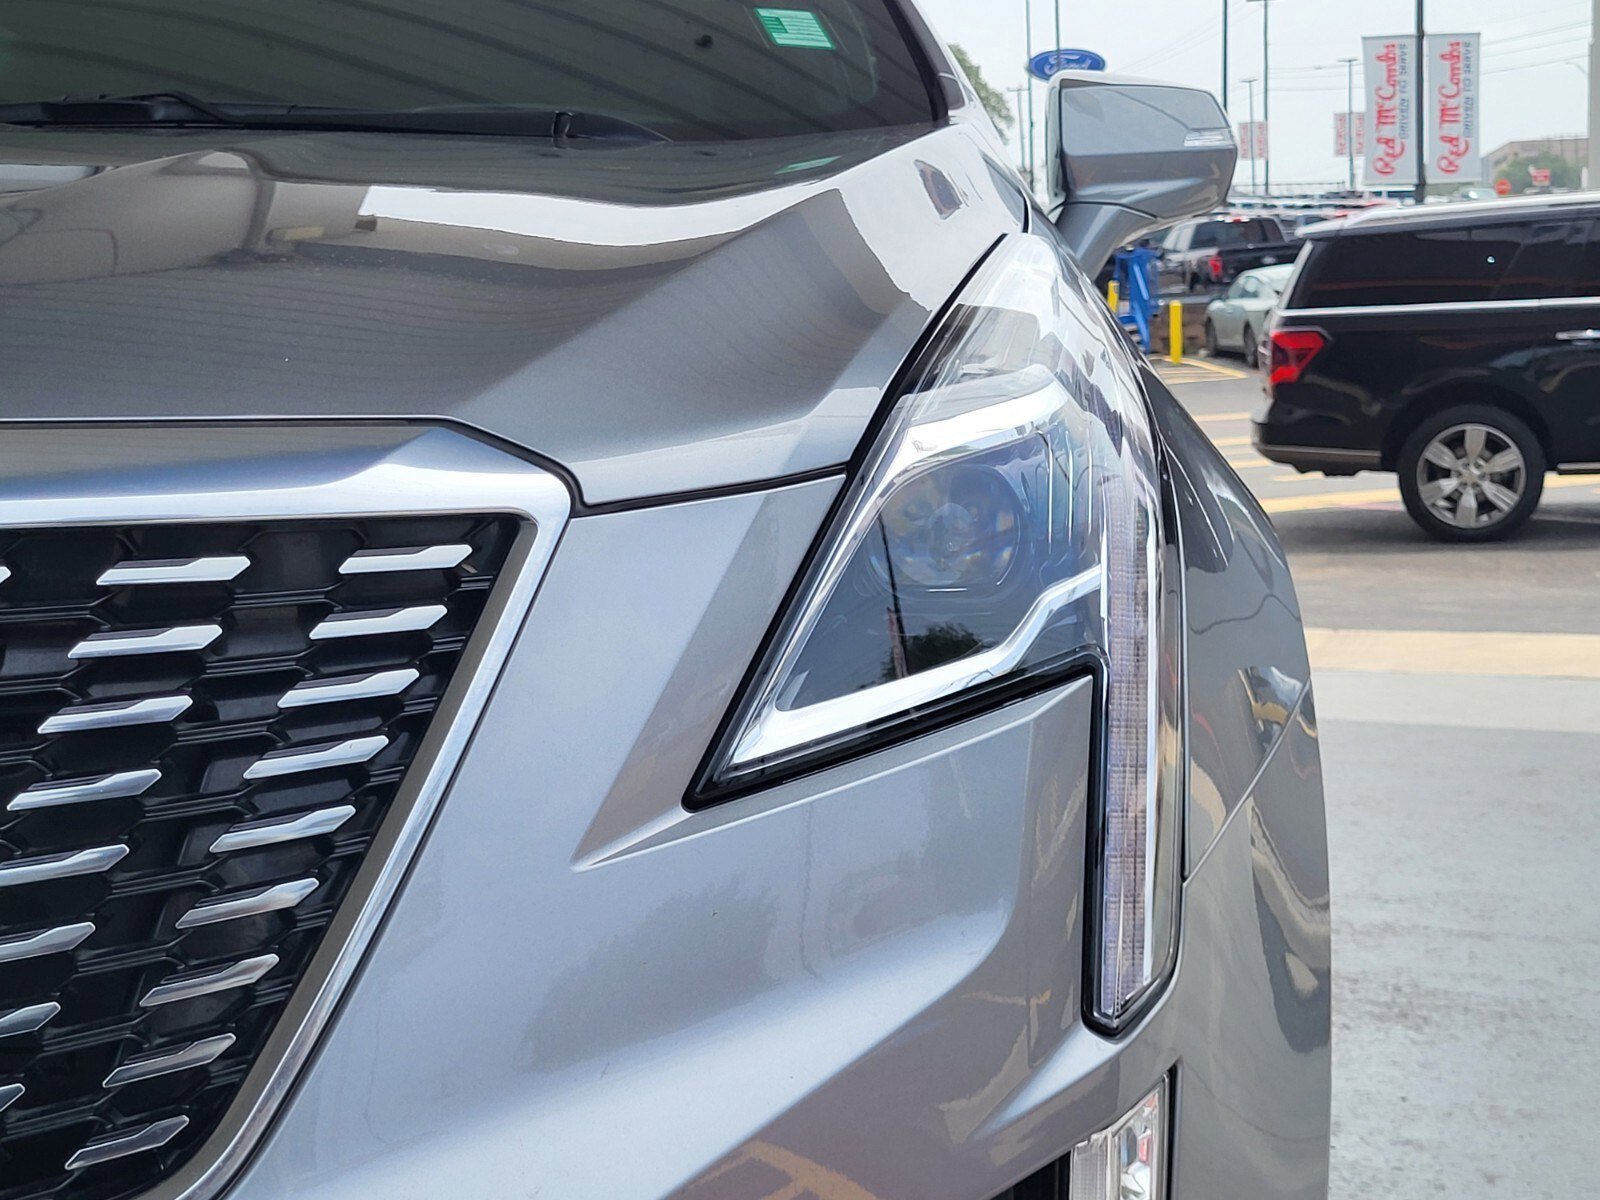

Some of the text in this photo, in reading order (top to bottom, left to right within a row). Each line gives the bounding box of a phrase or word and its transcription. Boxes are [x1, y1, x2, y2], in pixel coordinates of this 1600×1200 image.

[1043, 54, 1092, 75] Ford
[1373, 136, 1405, 176] Red
[1437, 135, 1469, 175] Red
